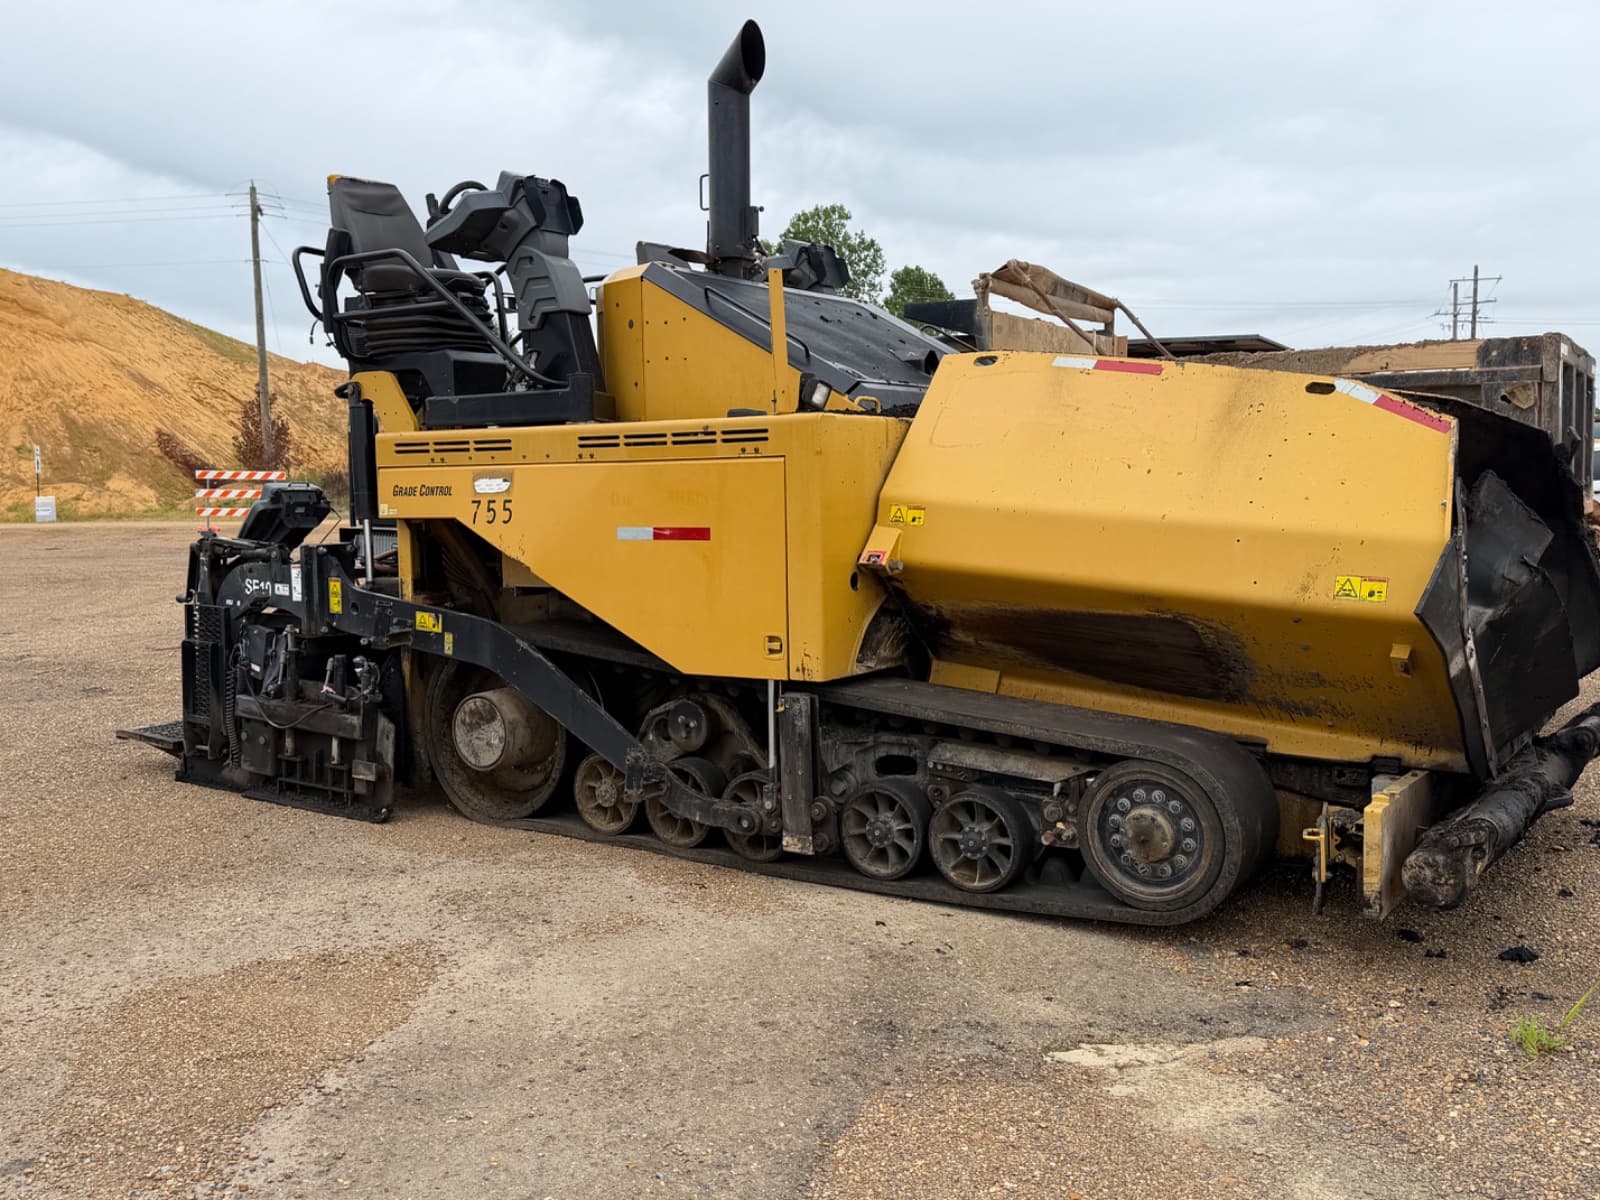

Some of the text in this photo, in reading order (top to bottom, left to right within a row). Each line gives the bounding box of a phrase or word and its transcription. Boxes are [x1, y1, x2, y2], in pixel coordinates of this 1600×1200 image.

[393, 484, 452, 497] GRADE CONTROL
[471, 499, 512, 525] 755
